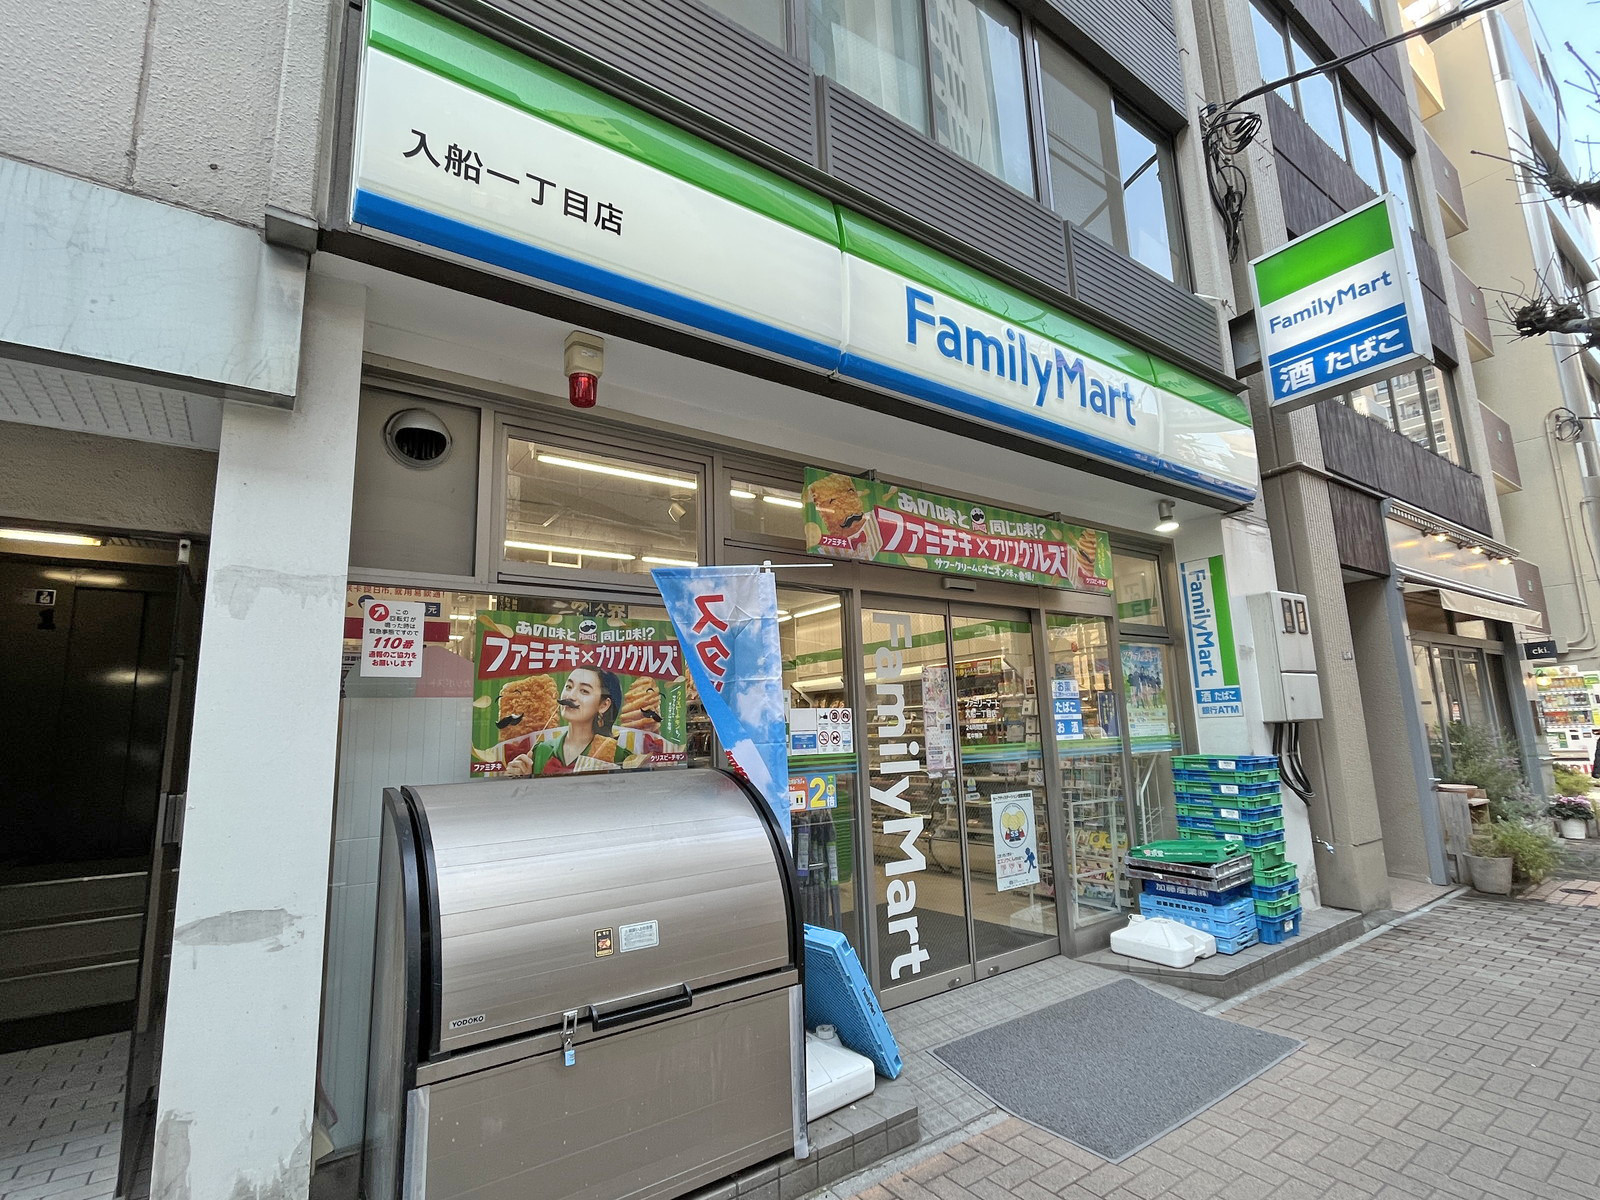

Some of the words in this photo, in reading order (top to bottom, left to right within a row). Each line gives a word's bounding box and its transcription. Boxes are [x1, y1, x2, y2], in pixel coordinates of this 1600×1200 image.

[402, 128, 624, 236] 入船一丁目店
[1269, 270, 1392, 335] FamilyMart
[905, 285, 1136, 426] FamilyMart
[1279, 356, 1316, 393] 酒
[1325, 328, 1404, 374] たばこ
[897, 491, 970, 529] あの味と
[989, 519, 1046, 539] 同じ味!?
[822, 536, 847, 547] ファミチキ
[515, 620, 577, 642] あの味と
[600, 626, 656, 643] 同じ味!?
[1188, 569, 1217, 677] FamilyMart
[373, 636, 414, 649] 110番
[368, 650, 417, 659] 通報のご協力を
[371, 659, 414, 667] お願いします
[1200, 690, 1212, 703] 酒
[1214, 690, 1237, 701] たばこ
[1055, 701, 1077, 713] たばこ
[1202, 704, 1240, 715] 銀行ATM
[869, 612, 930, 981] FamilyMart
[452, 1015, 485, 1028] YODOKO
